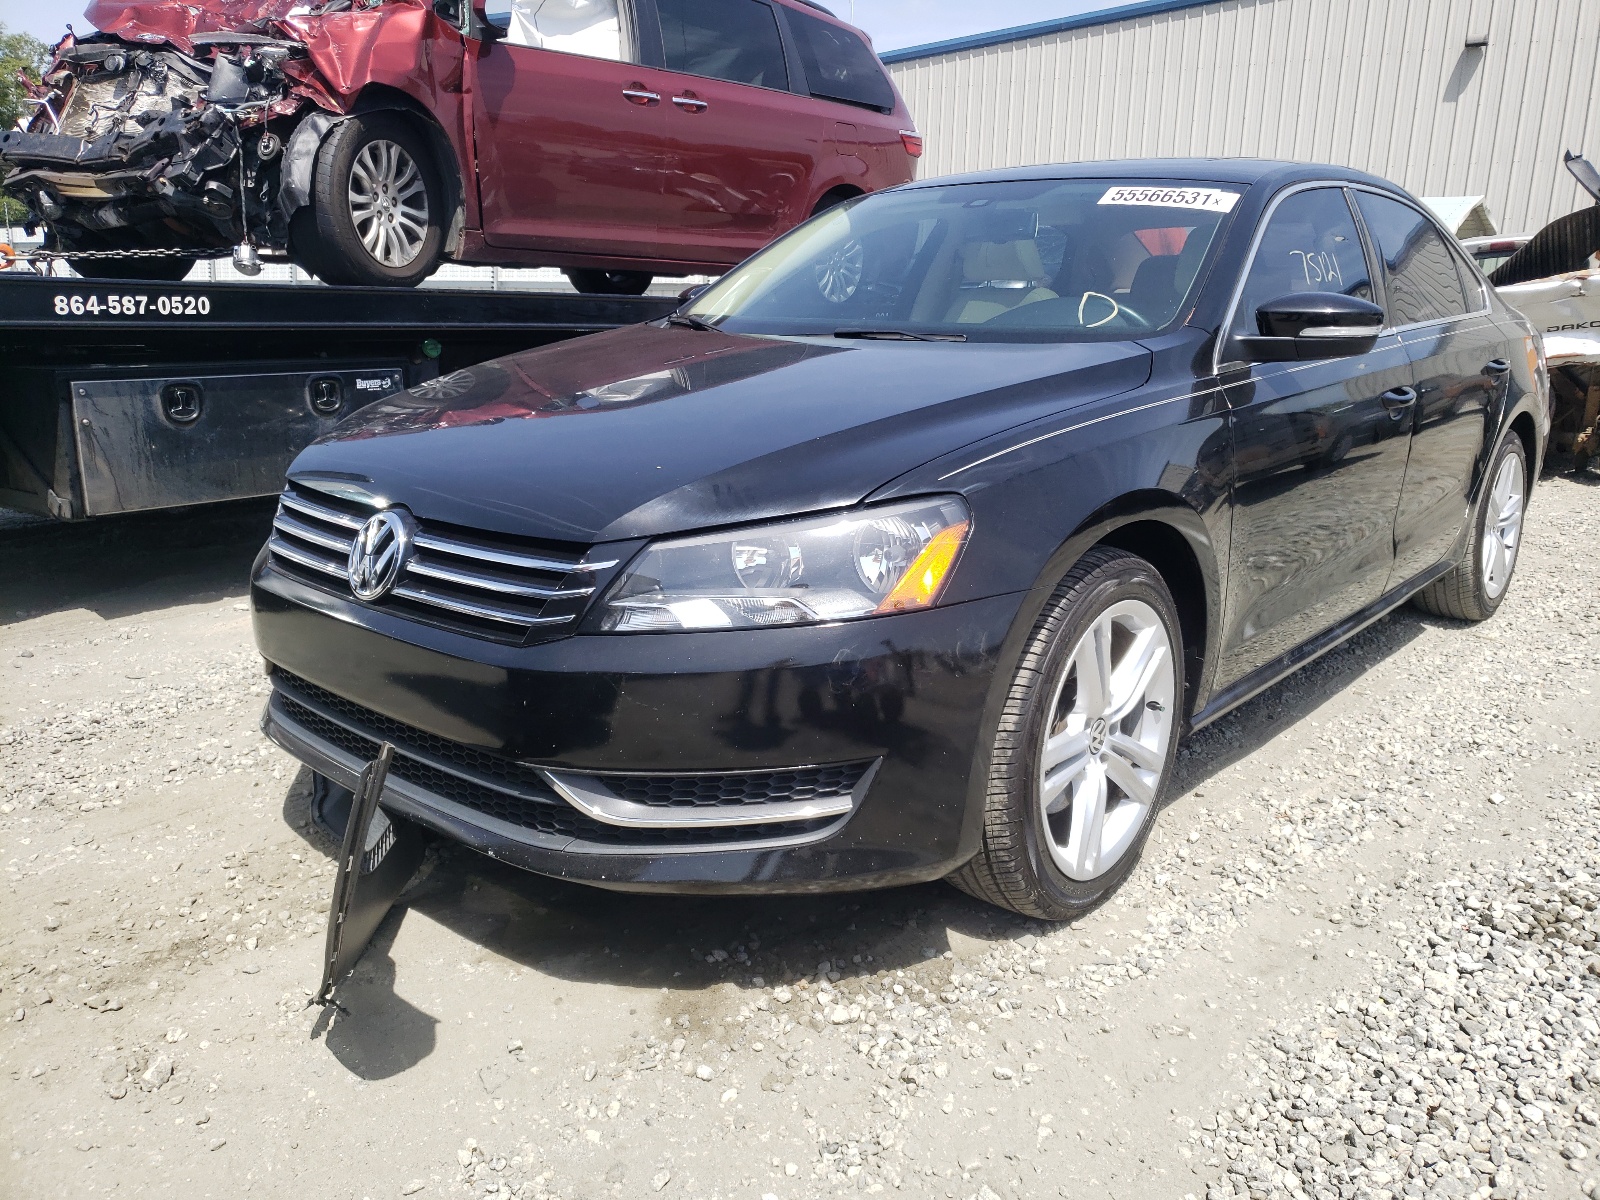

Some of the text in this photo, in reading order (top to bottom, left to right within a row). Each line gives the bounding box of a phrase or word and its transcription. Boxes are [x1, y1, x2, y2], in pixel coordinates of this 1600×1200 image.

[1111, 188, 1213, 206] 55566531
[54, 295, 210, 315] 864-587-0520
[355, 378, 382, 389] Buyers
